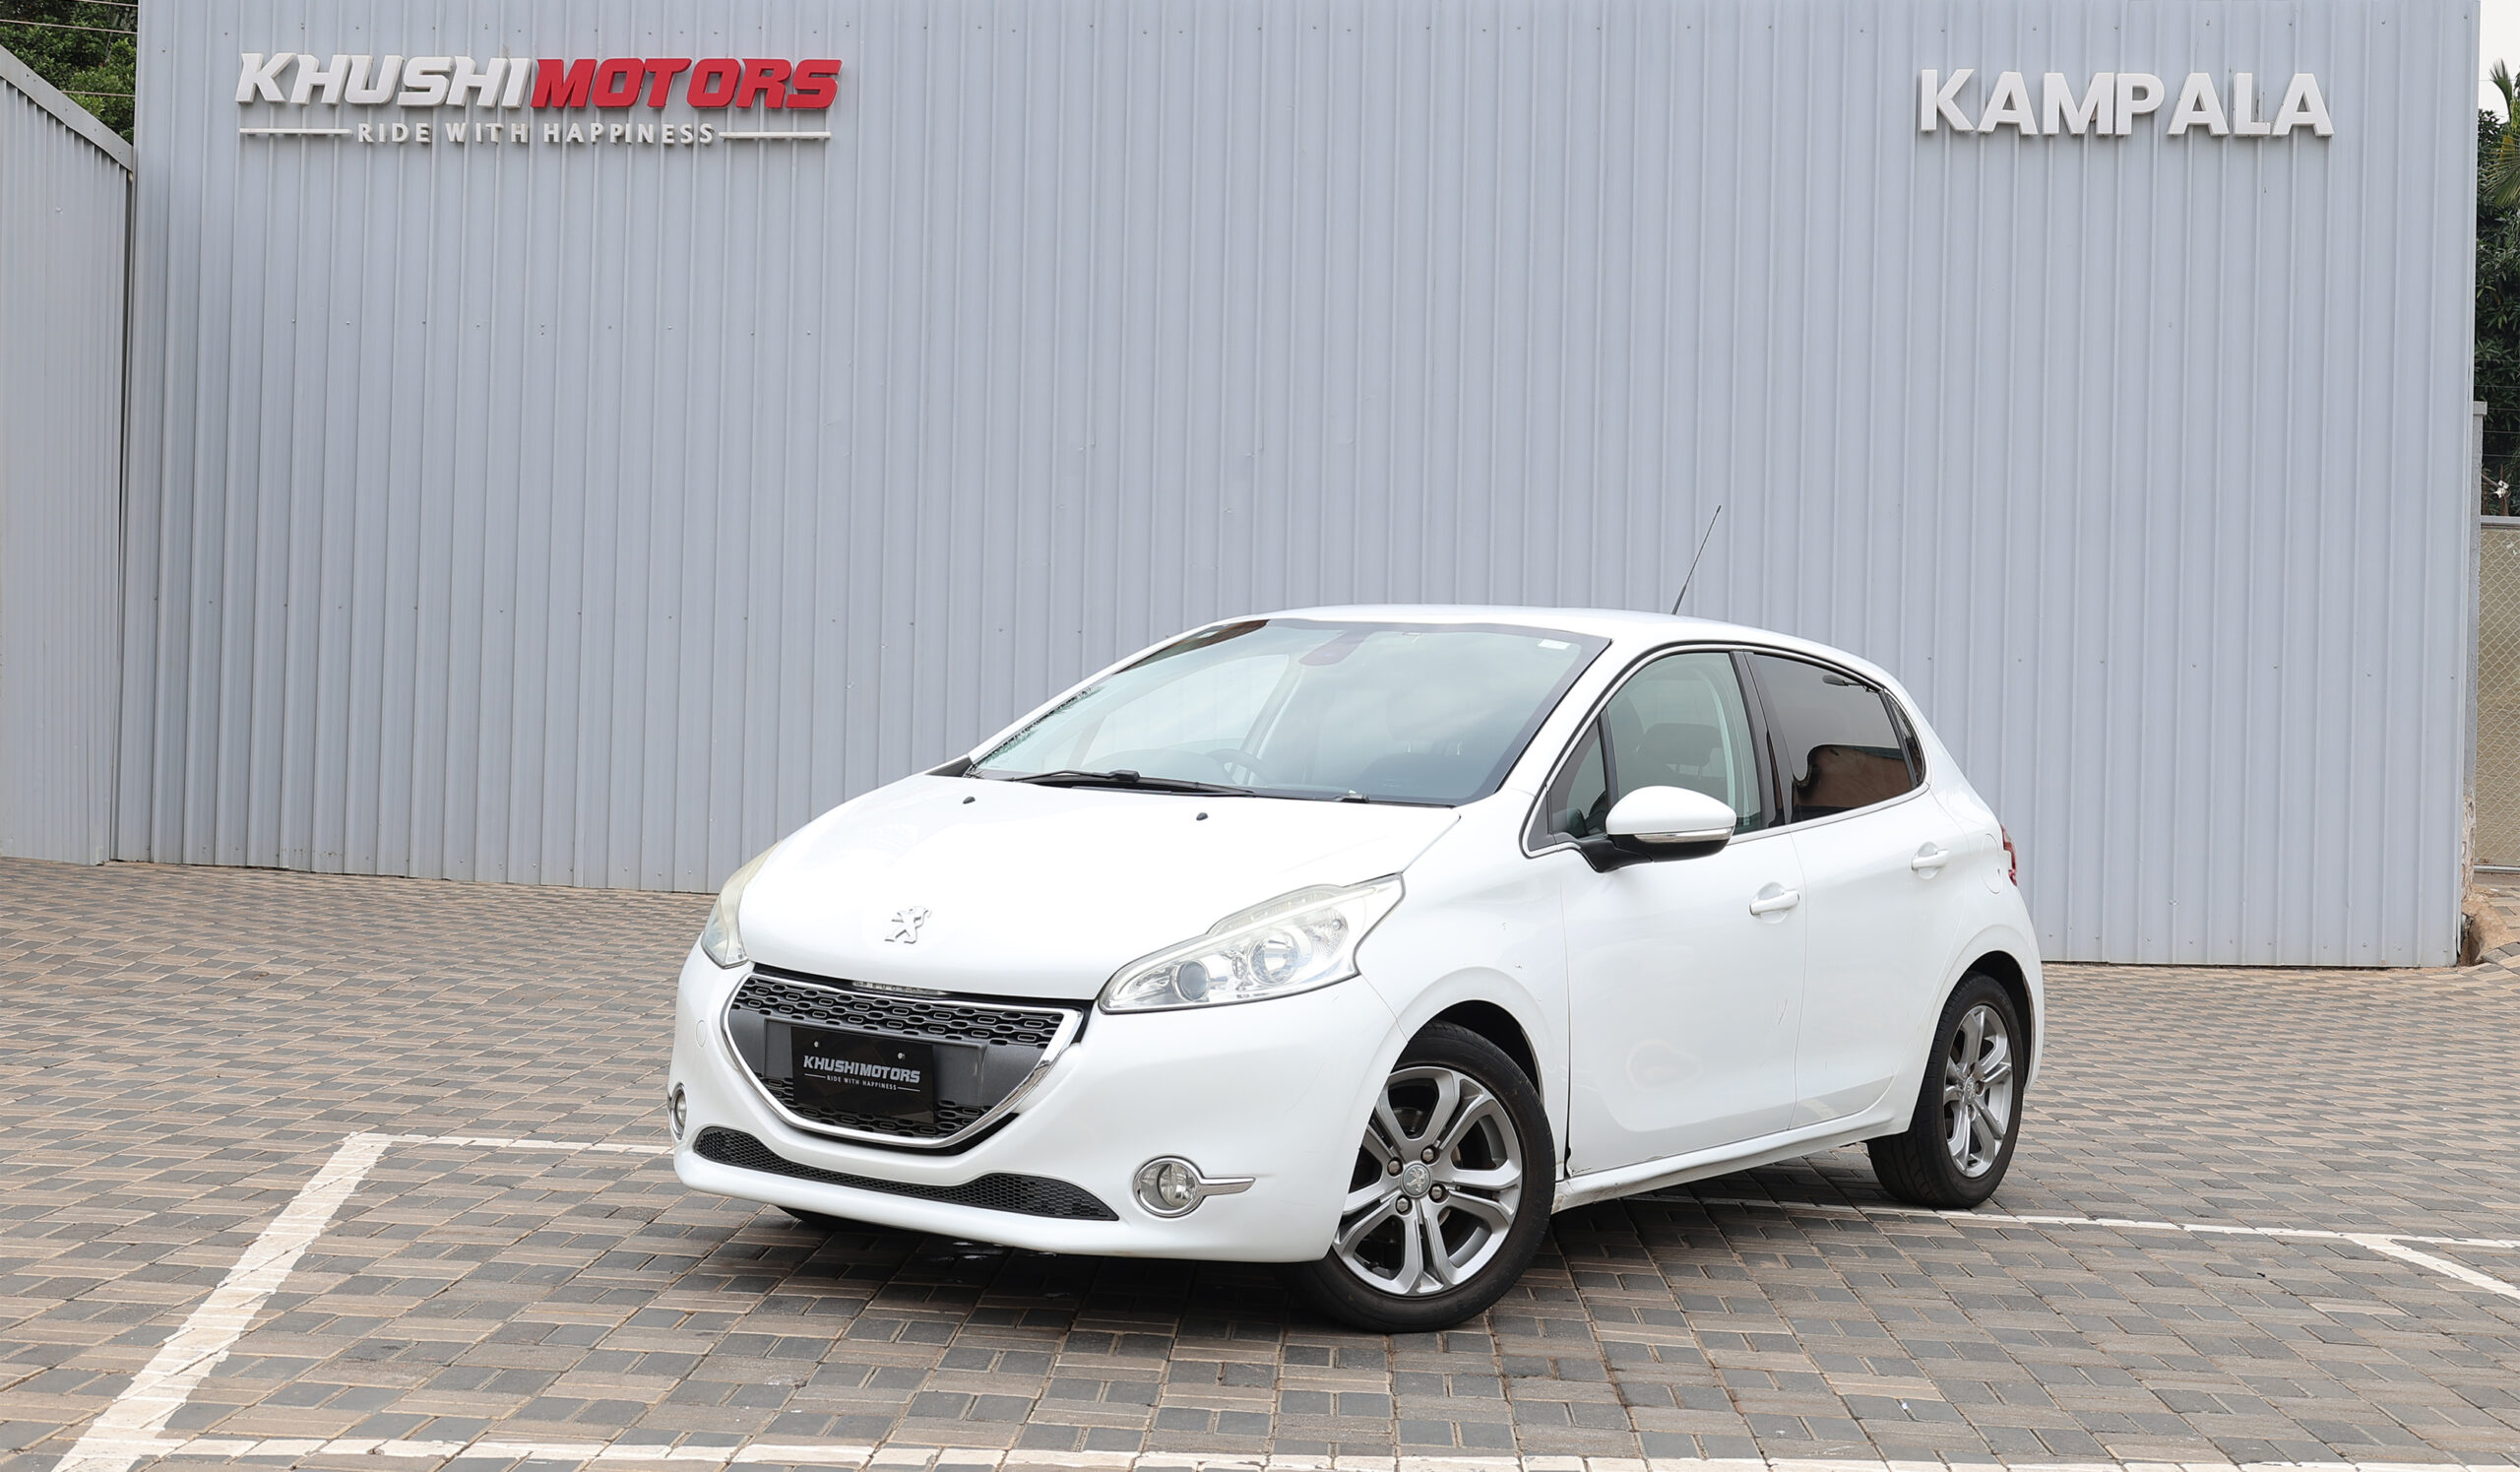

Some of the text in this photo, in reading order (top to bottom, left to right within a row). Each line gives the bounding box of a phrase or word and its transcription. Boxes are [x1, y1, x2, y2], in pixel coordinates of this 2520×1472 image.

[1921, 68, 2334, 137] KAMPALA
[357, 122, 715, 145] RIDE WITH HAPPINESS
[827, 1074, 897, 1091] RIDE WITH HAPPINESS
